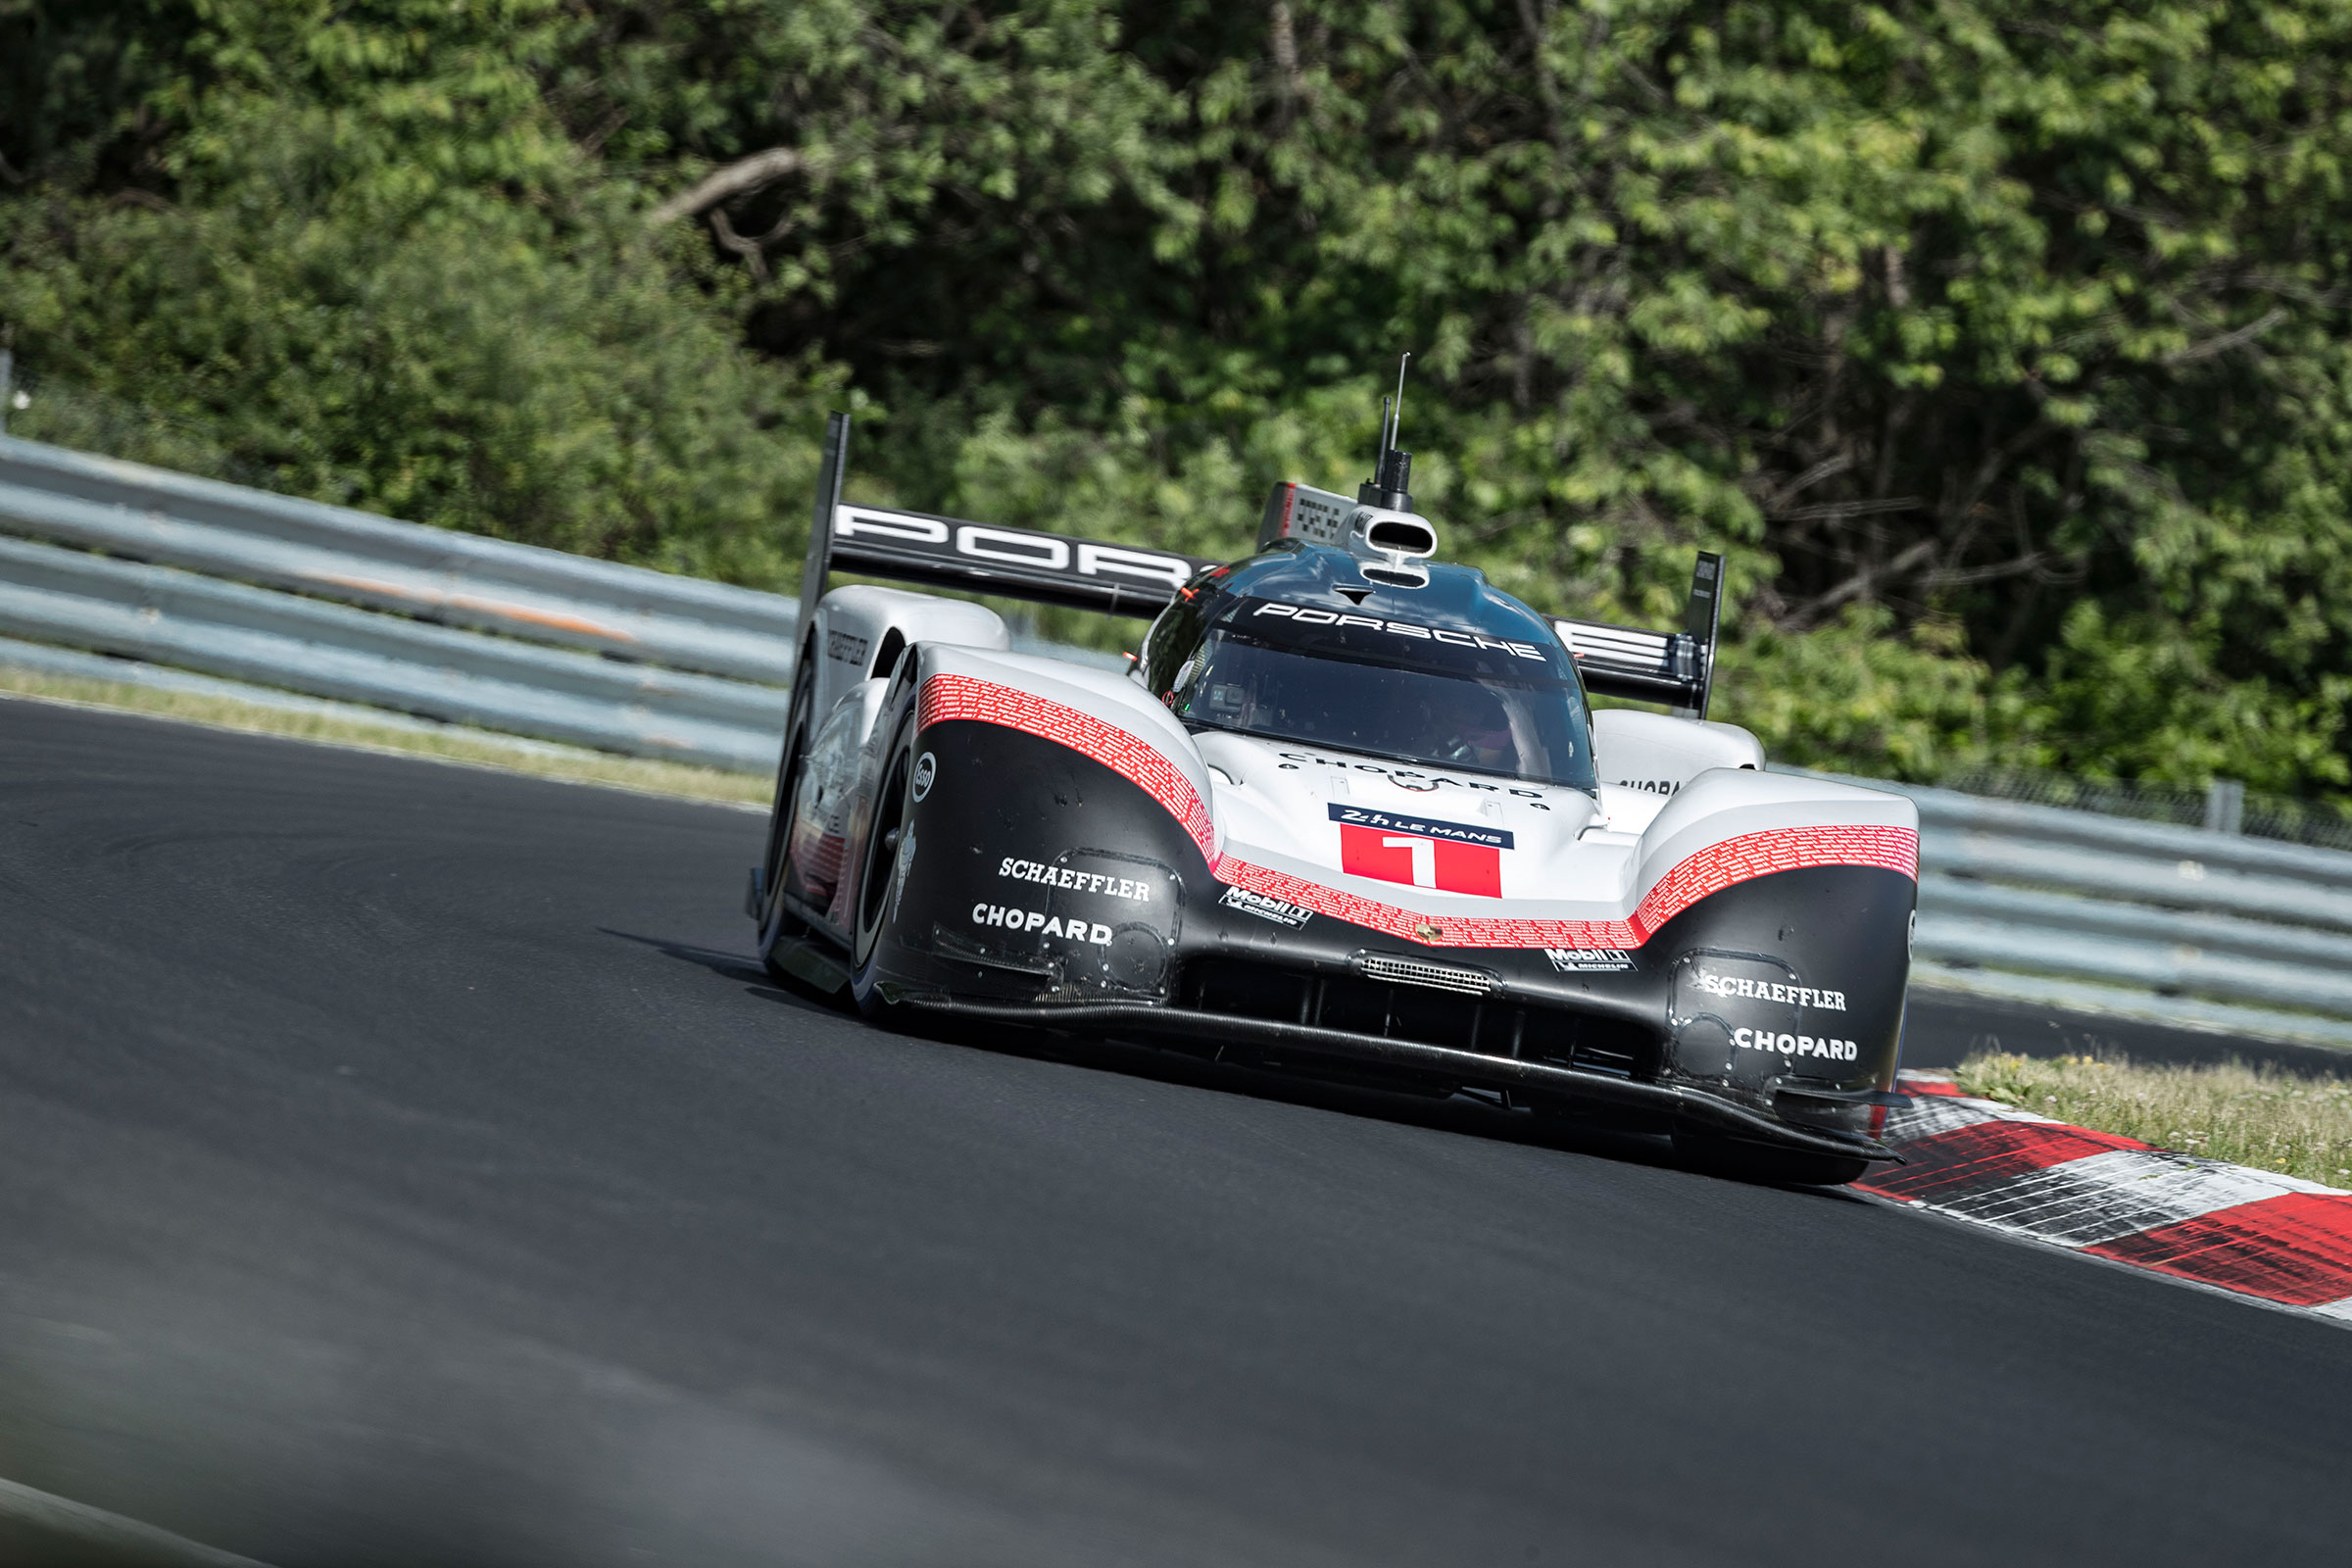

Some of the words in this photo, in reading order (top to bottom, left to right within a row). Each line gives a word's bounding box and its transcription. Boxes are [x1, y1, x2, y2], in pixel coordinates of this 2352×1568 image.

[1253, 603, 1546, 662] PORSCHE
[1279, 753, 1544, 799] CHOPARD
[1395, 820, 1427, 832] LE
[1430, 826, 1503, 845] MANS
[999, 857, 1150, 902] SCHAEFFLER
[1383, 836, 1437, 889] 1
[1226, 886, 1290, 913] Mobil
[1244, 905, 1298, 925] MICHELIN
[971, 903, 1113, 946] CHOPARD
[1544, 948, 1609, 961] Mobil
[1703, 974, 1847, 1012] SCHAEFFLER
[1734, 1027, 1859, 1062] CHOPARD
